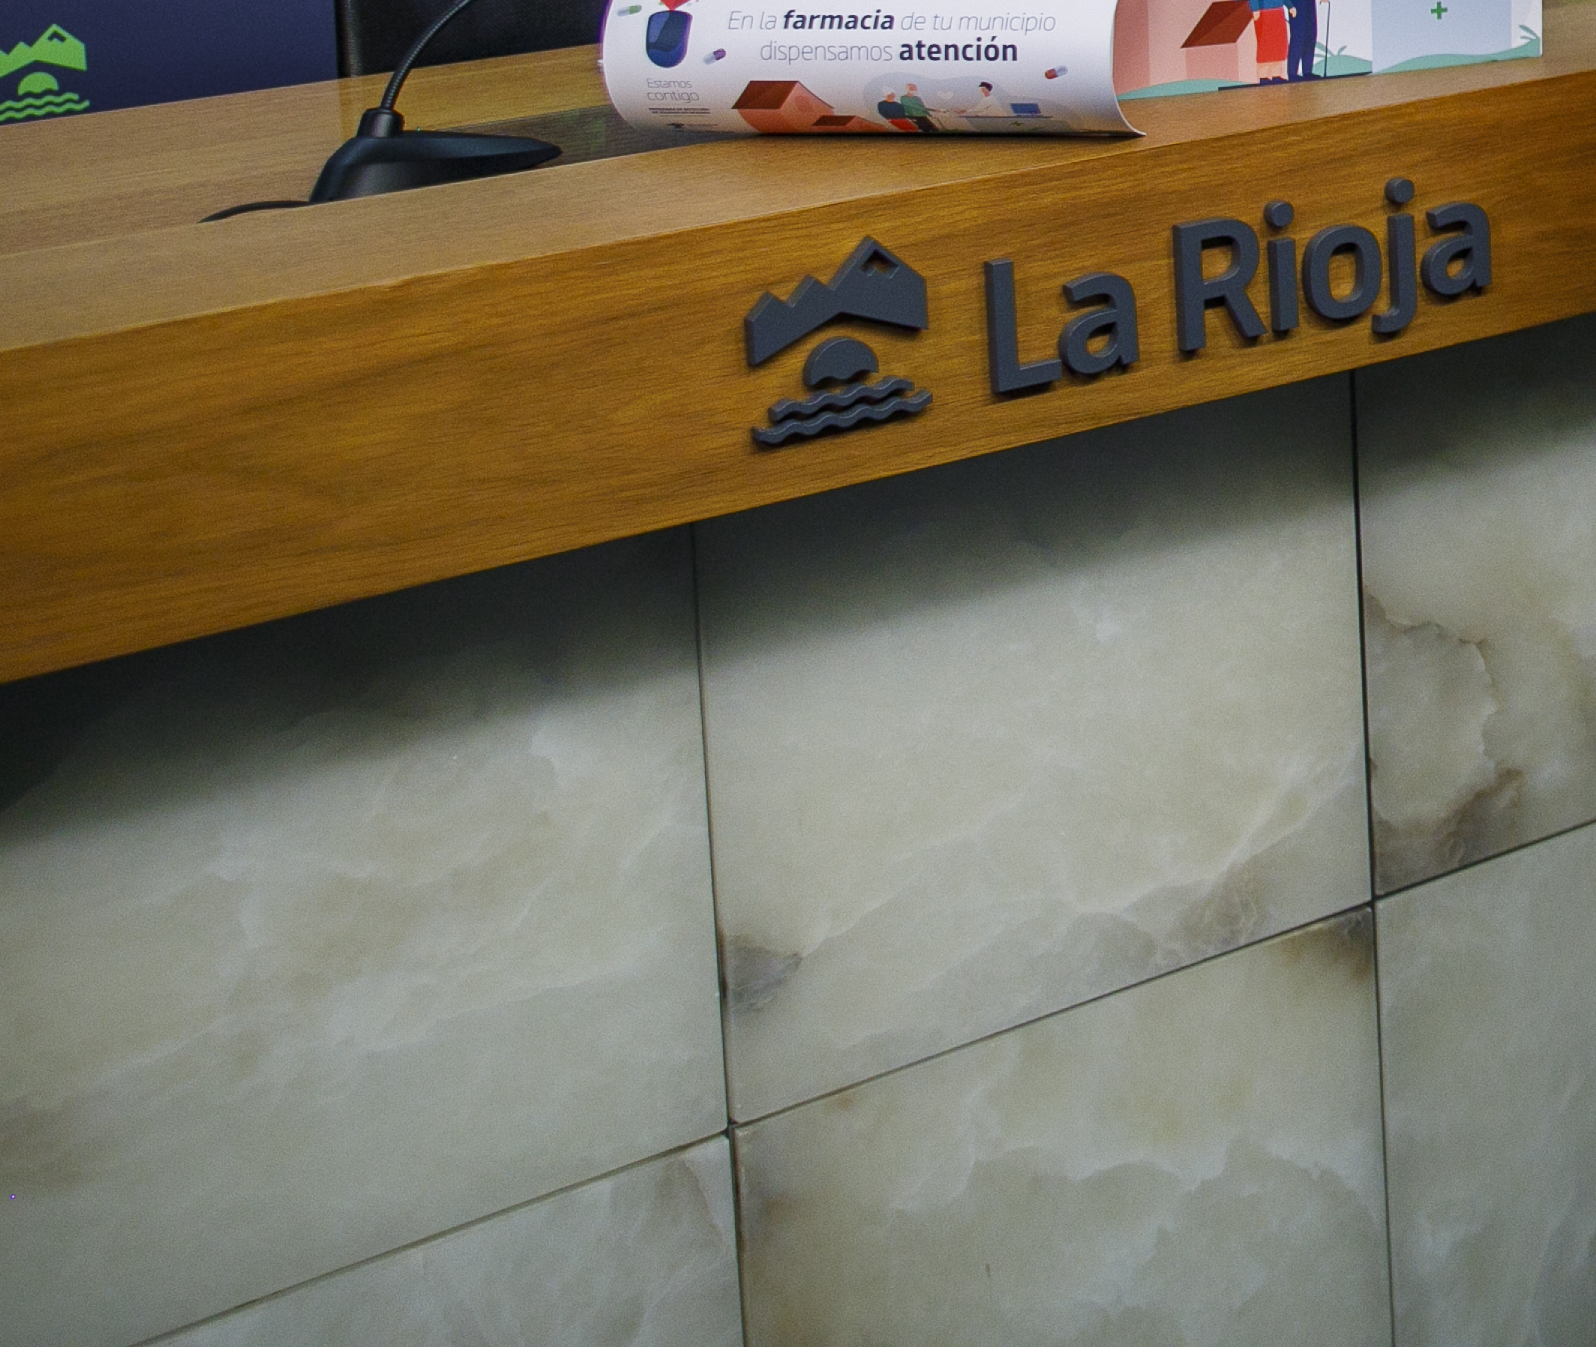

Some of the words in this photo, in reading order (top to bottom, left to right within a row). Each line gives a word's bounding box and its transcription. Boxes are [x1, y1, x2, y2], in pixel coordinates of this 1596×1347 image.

[727, 11, 753, 30] En
[758, 11, 777, 30] la
[783, 9, 895, 31] farmacia
[900, 12, 927, 31] de
[933, 14, 953, 31] tu
[958, 11, 1056, 35] municipio
[760, 39, 893, 65] dispensamos
[899, 35, 1018, 62] atención
[646, 78, 693, 89] Estamos
[646, 90, 700, 103] contigo
[985, 258, 1140, 397] La
[1172, 177, 1493, 354] Rioja
